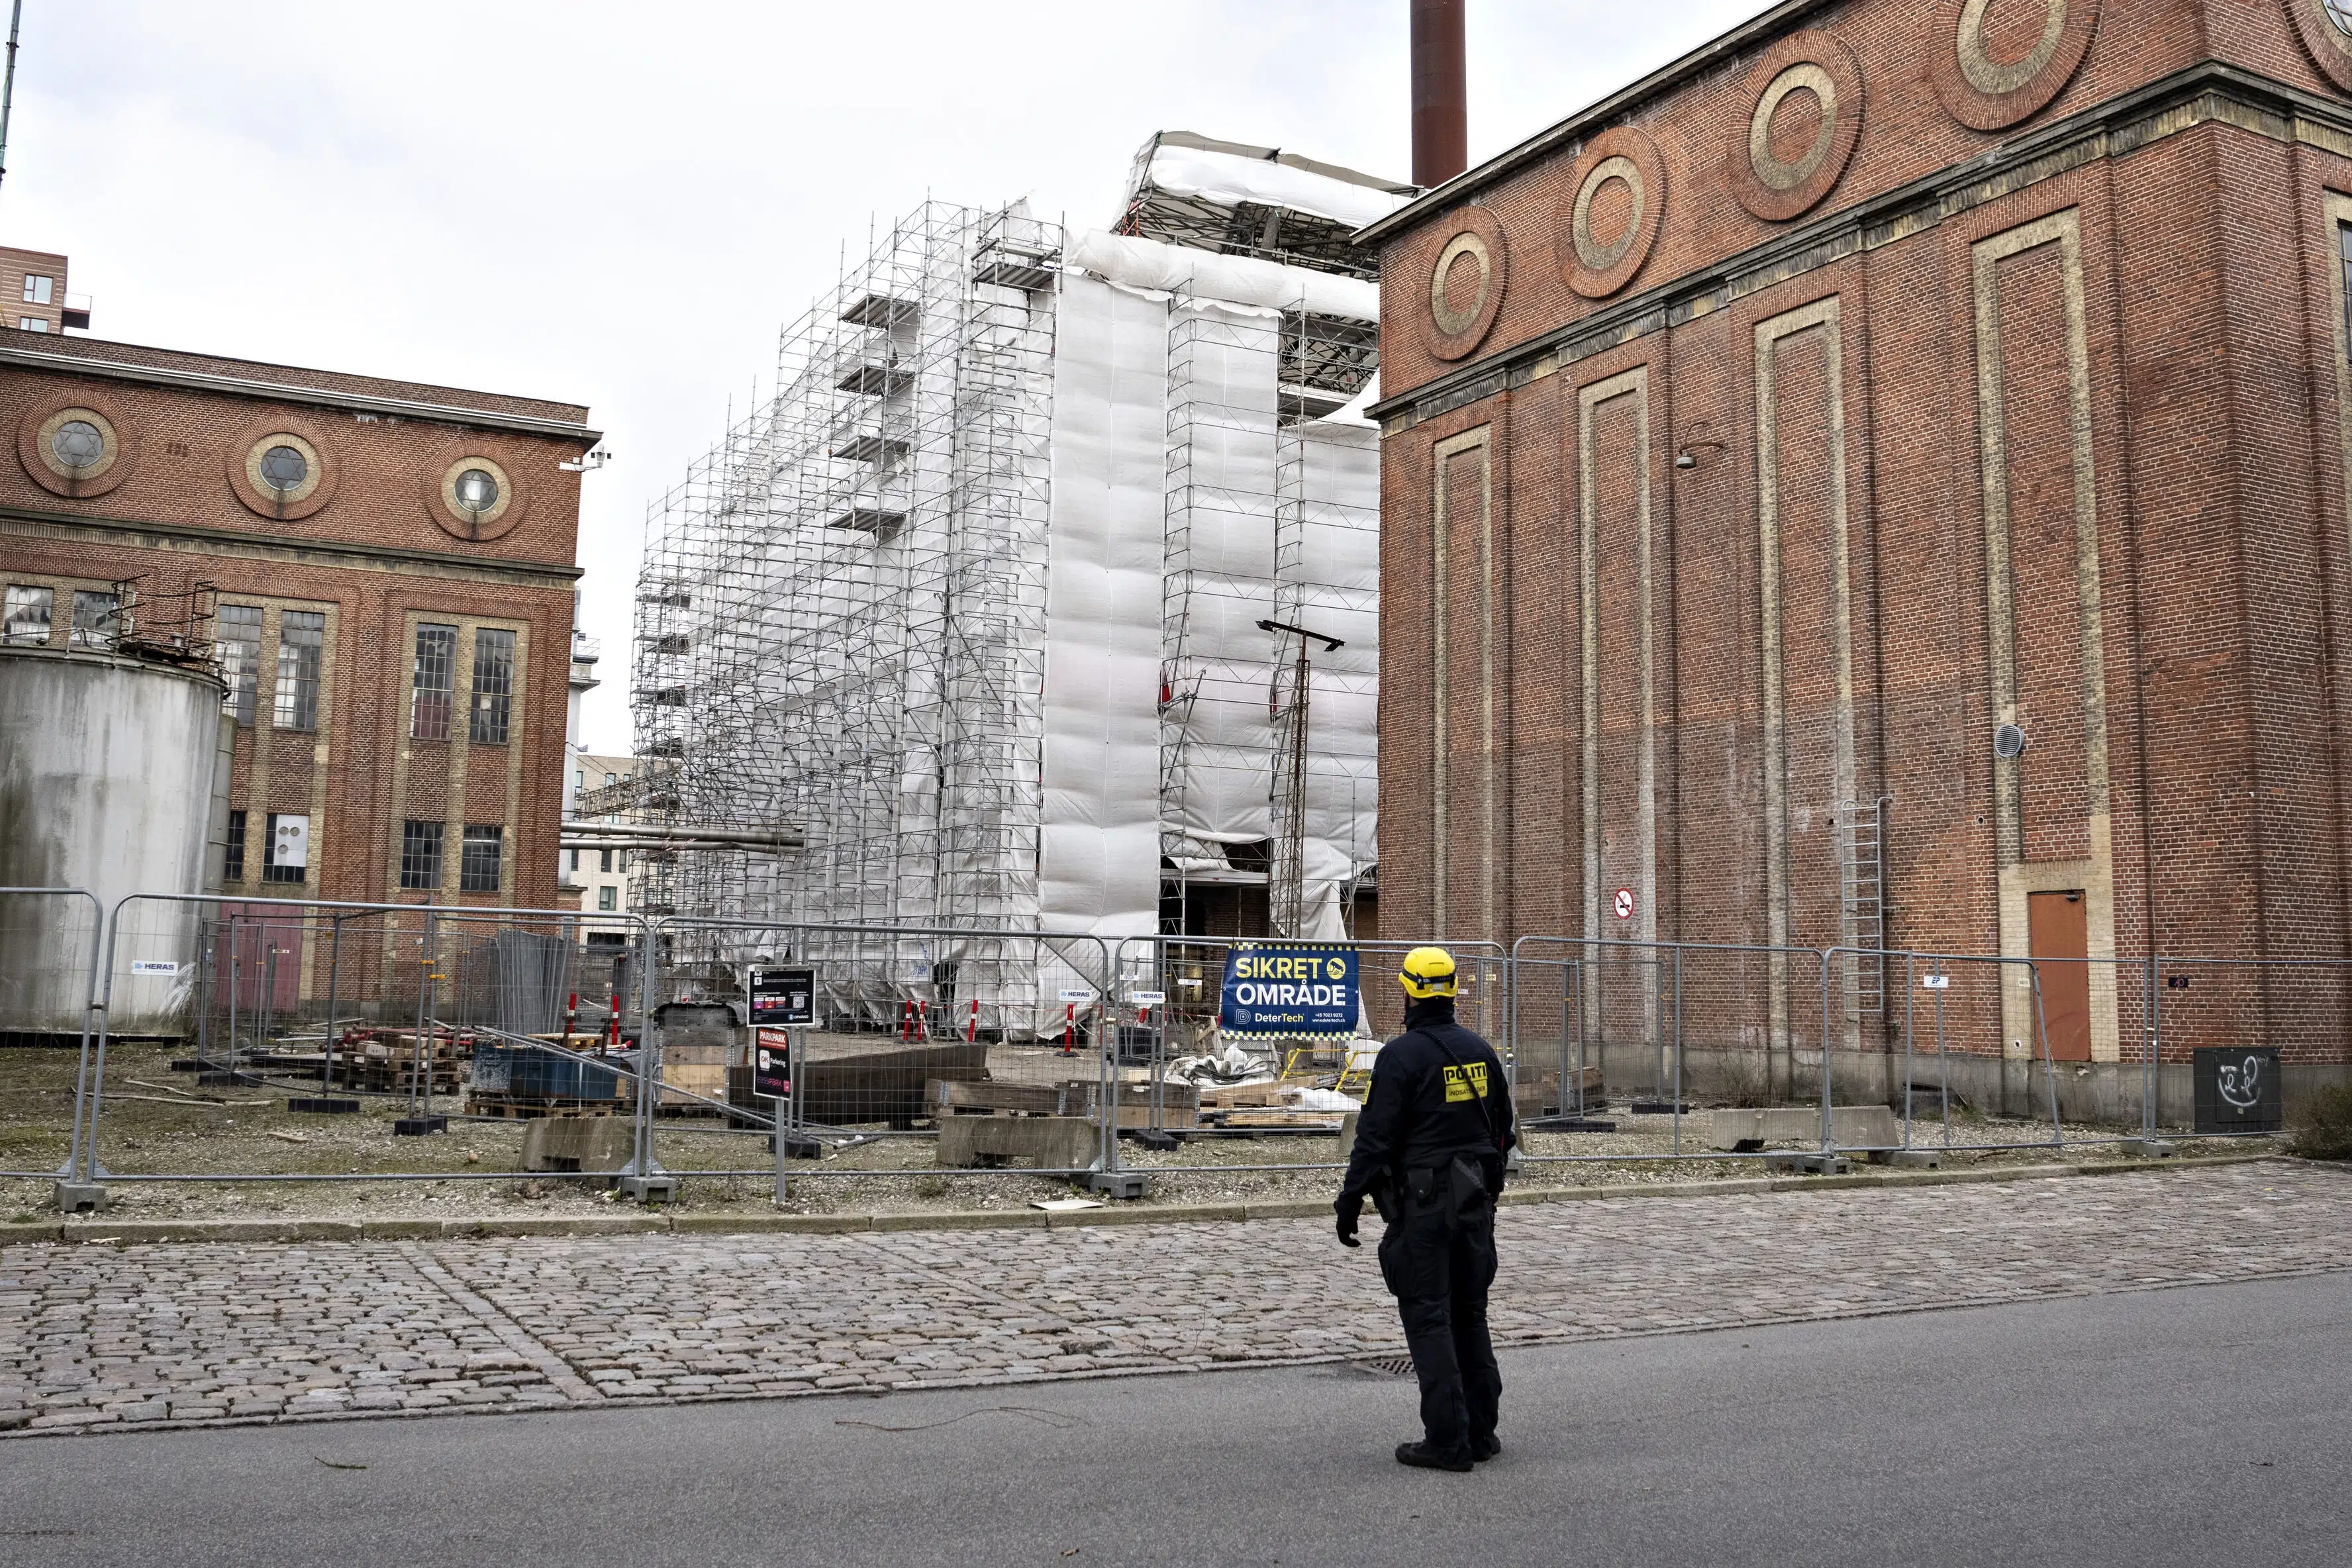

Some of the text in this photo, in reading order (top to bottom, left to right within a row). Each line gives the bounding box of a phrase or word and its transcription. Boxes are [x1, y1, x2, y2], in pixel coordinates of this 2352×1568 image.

[1236, 957, 1322, 979] SIKRET
[1236, 979, 1346, 1006] OMRÅDE
[1255, 1012, 1304, 1022] DeterTech
[760, 1031, 787, 1044] PARKPARK
[770, 1057, 787, 1068] Parkering
[1445, 1065, 1487, 1082] POLITI
[1449, 1086, 1486, 1097] INDSATSDER
